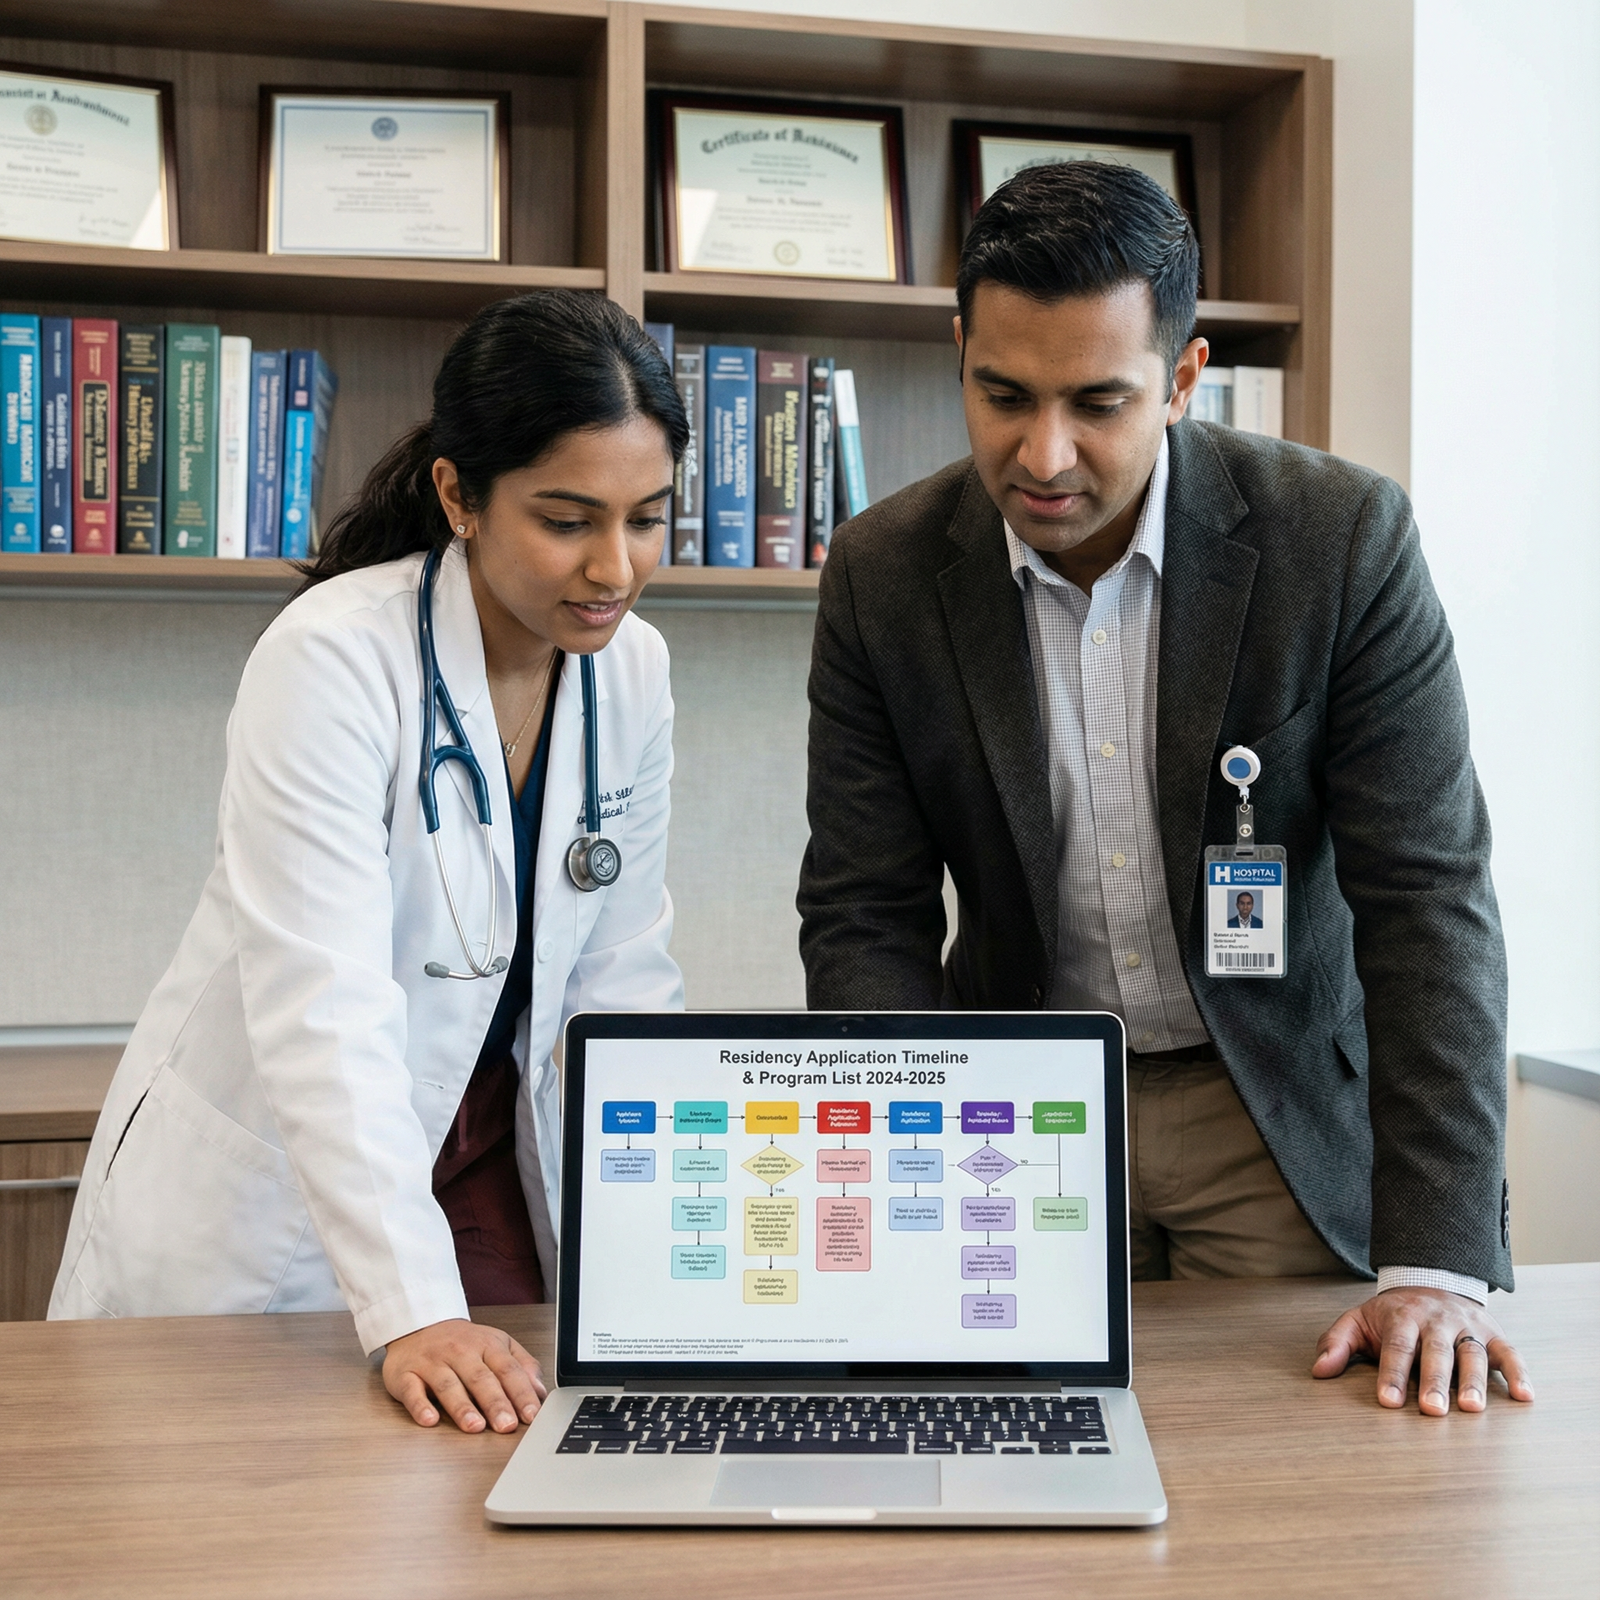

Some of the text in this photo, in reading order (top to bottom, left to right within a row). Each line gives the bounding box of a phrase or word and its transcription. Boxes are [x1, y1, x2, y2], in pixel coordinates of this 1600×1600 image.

[720, 1050, 969, 1067] Residency Application Timeline
[742, 1071, 946, 1088] & Program List 2024-2025
